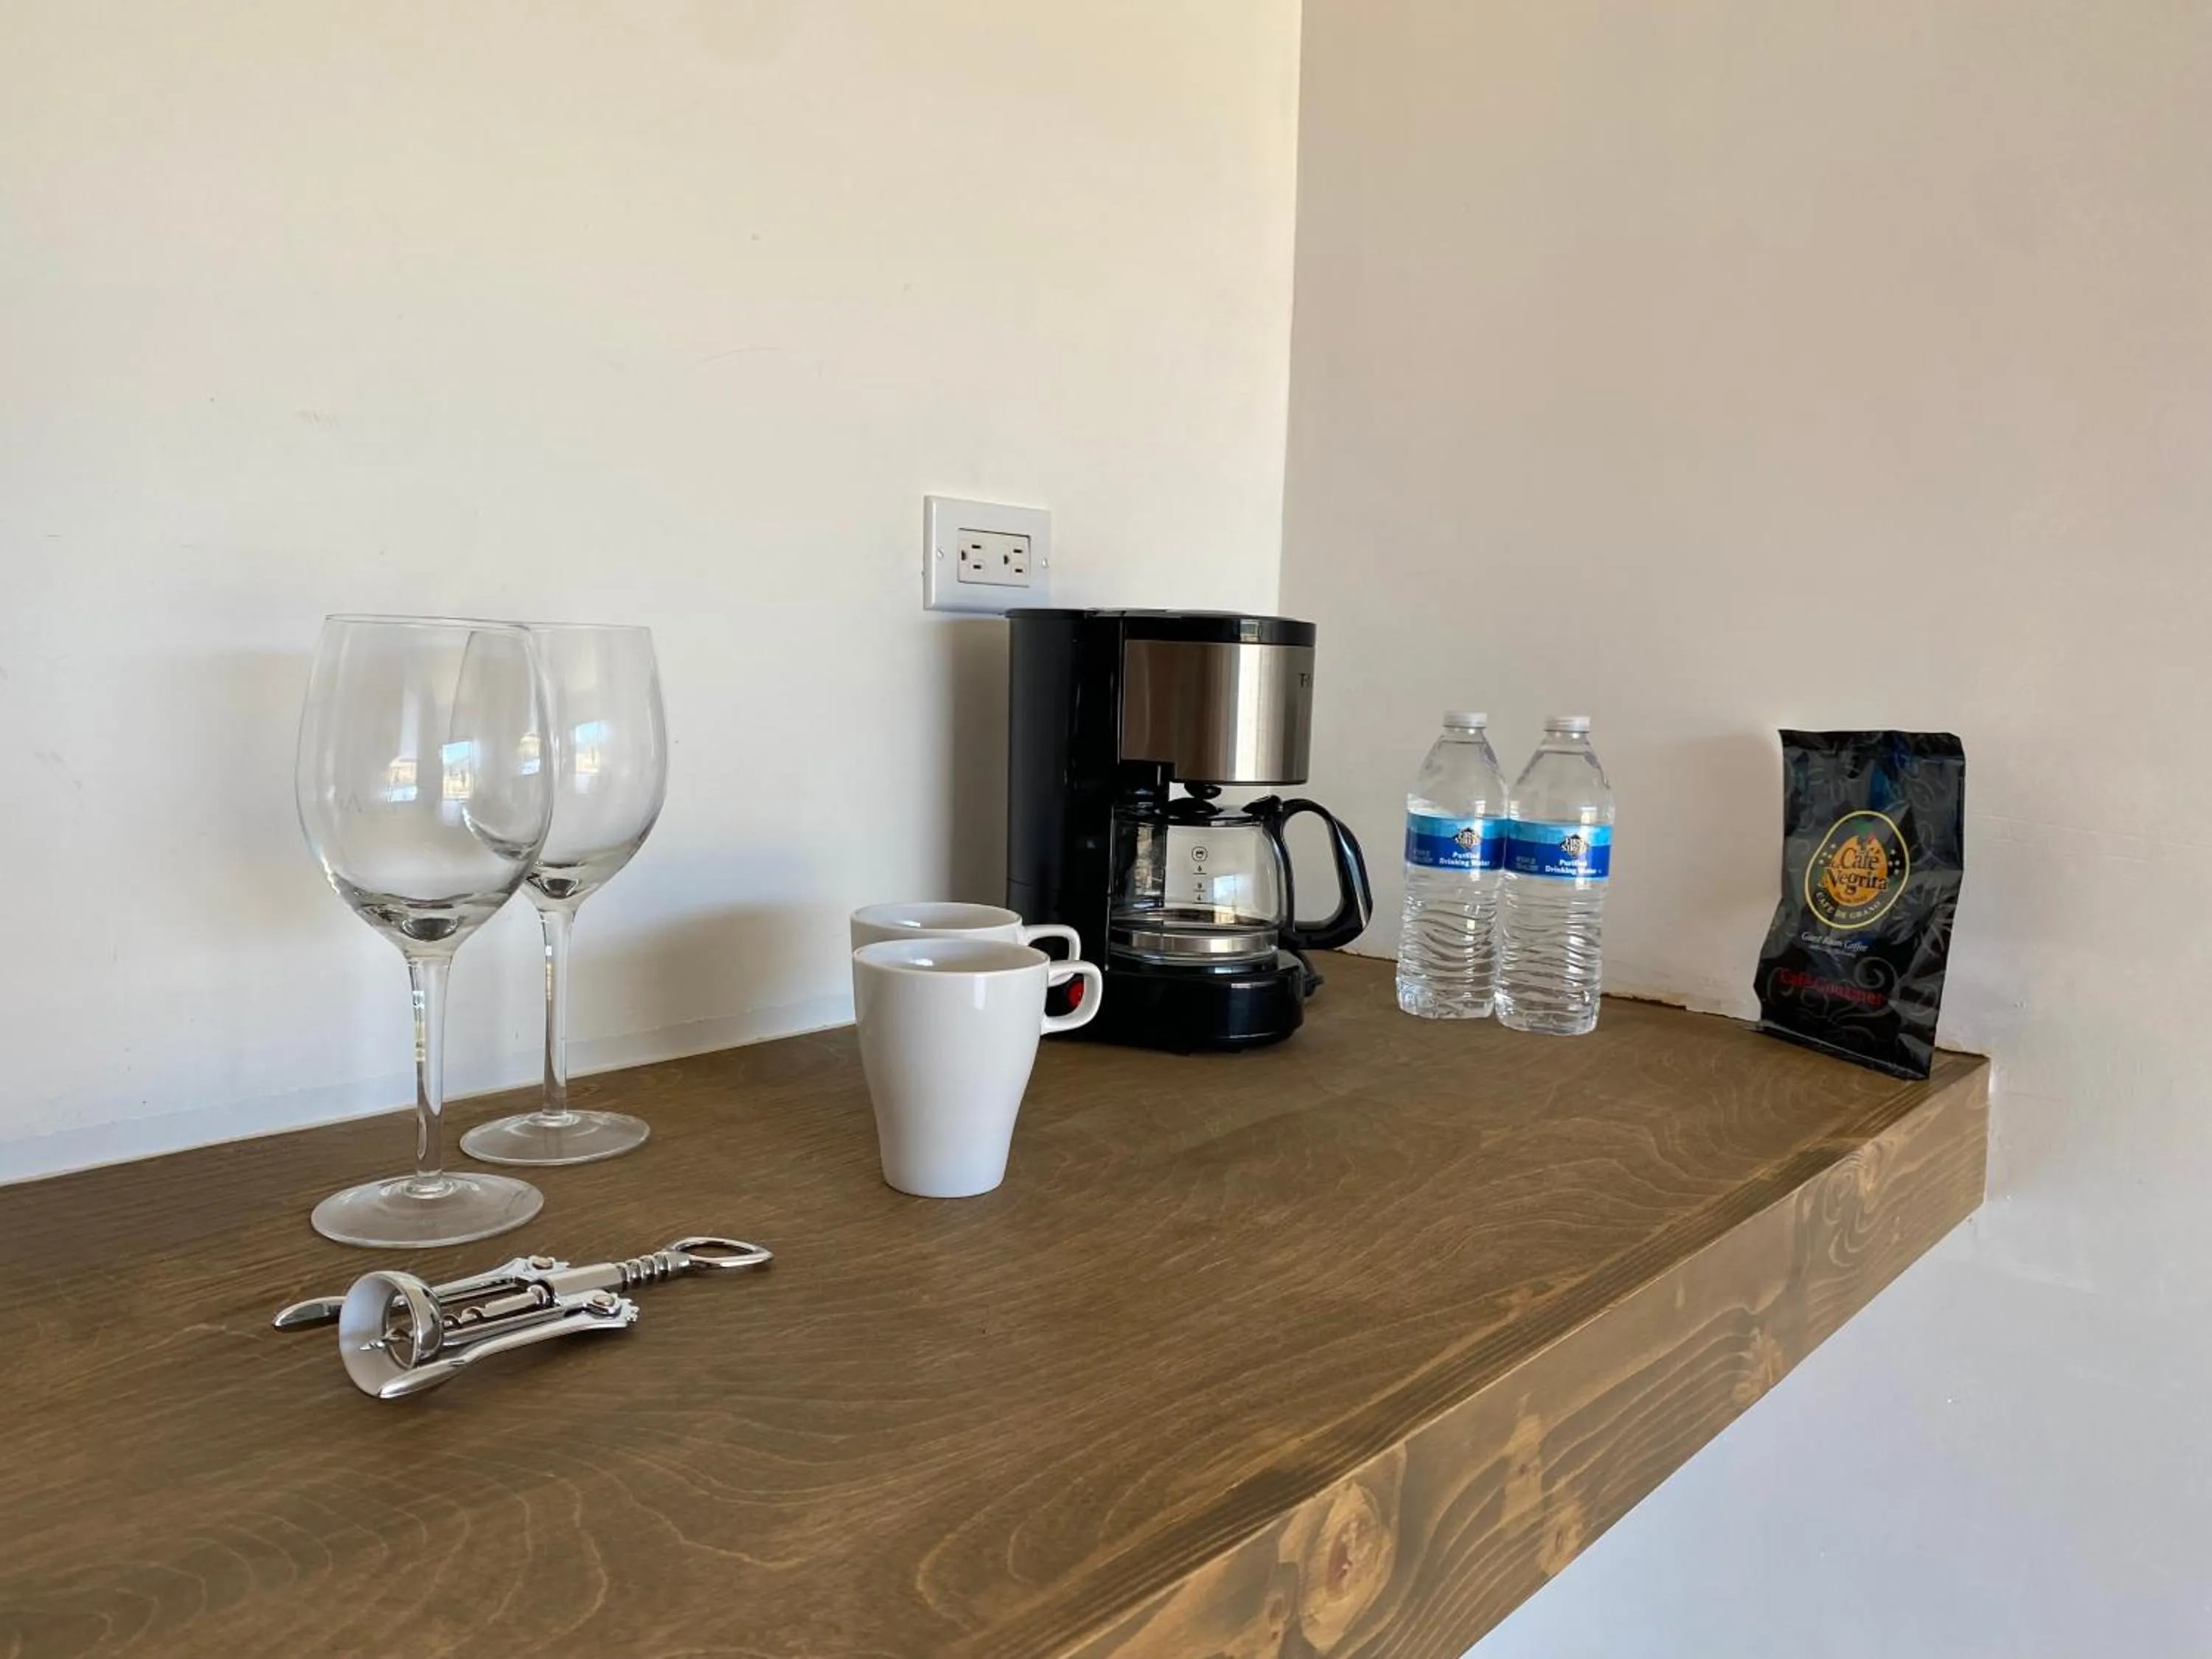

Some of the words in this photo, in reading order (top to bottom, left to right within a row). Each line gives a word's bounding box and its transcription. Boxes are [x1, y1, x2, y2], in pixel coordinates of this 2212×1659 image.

[1439, 858, 1470, 867] Drinking
[1840, 847, 1879, 870] Café
[1545, 866, 1577, 875] Drinking
